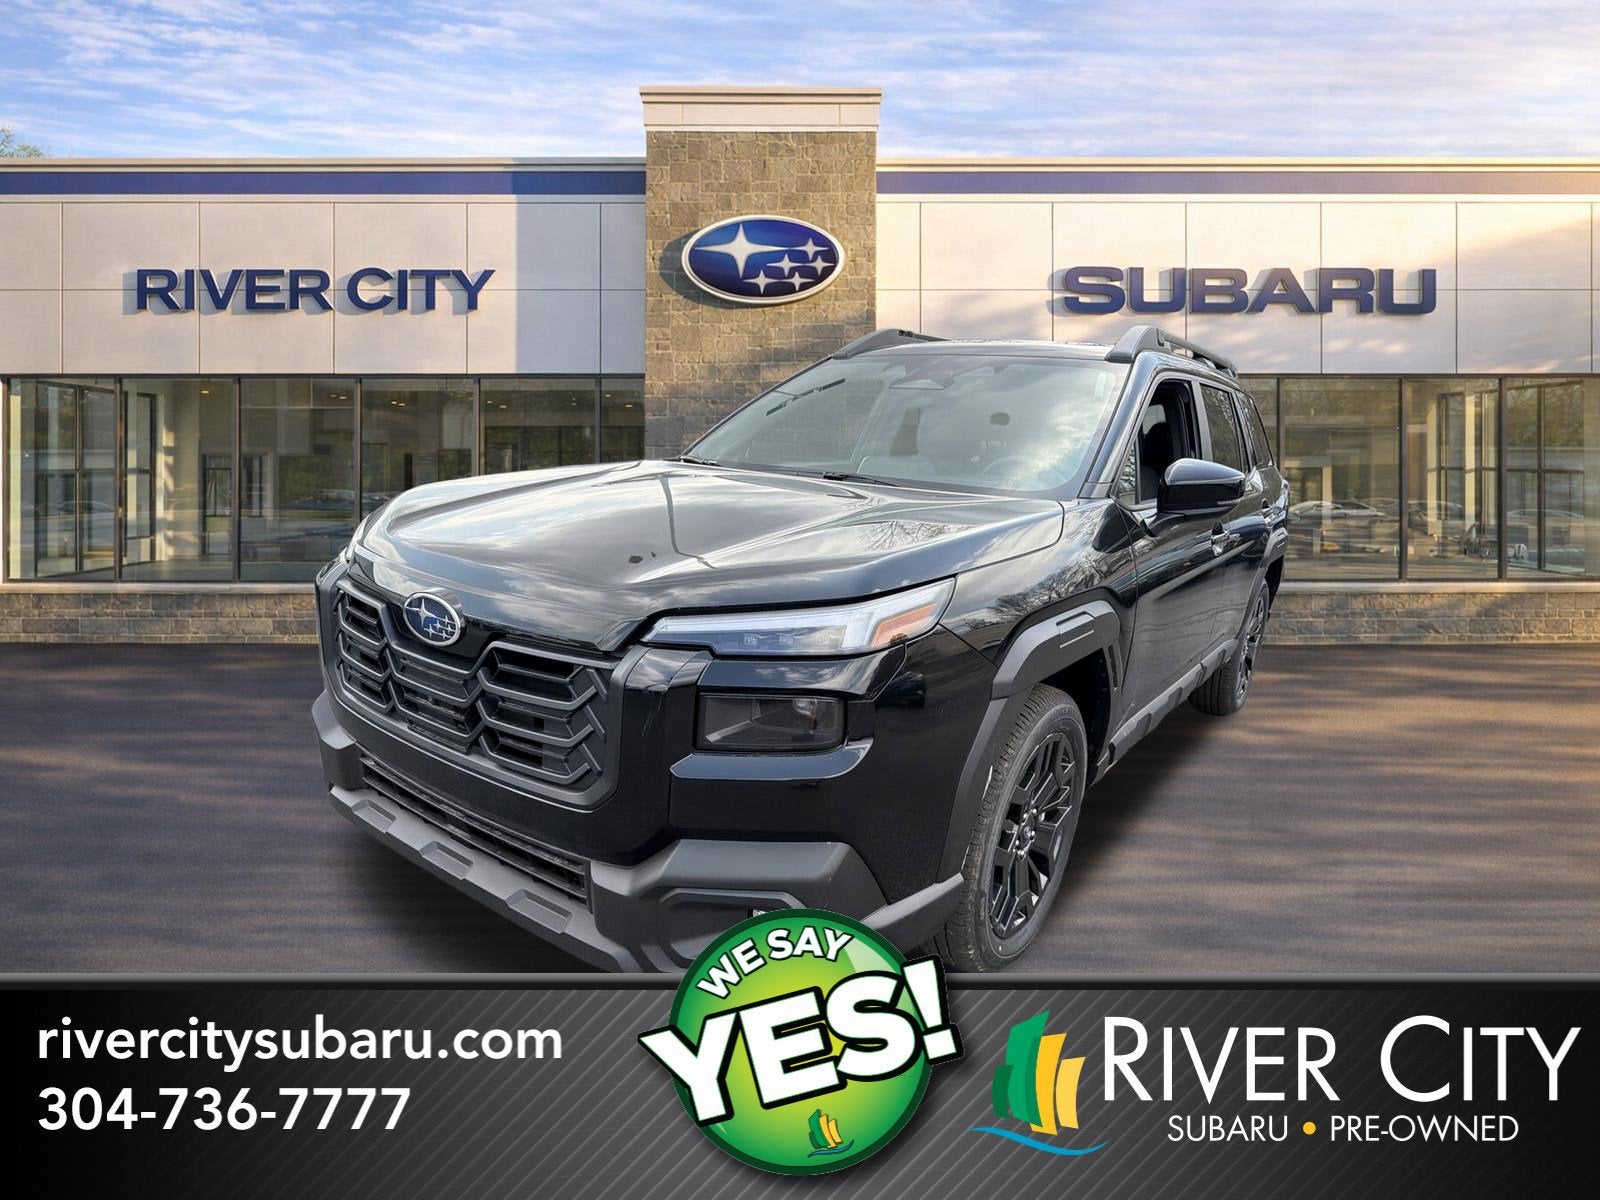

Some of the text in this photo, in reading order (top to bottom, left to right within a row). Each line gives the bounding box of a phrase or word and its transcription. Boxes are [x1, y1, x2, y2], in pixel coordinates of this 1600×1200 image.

[136, 267, 495, 310] RIVER CITY
[1063, 266, 1437, 314] SUBARU
